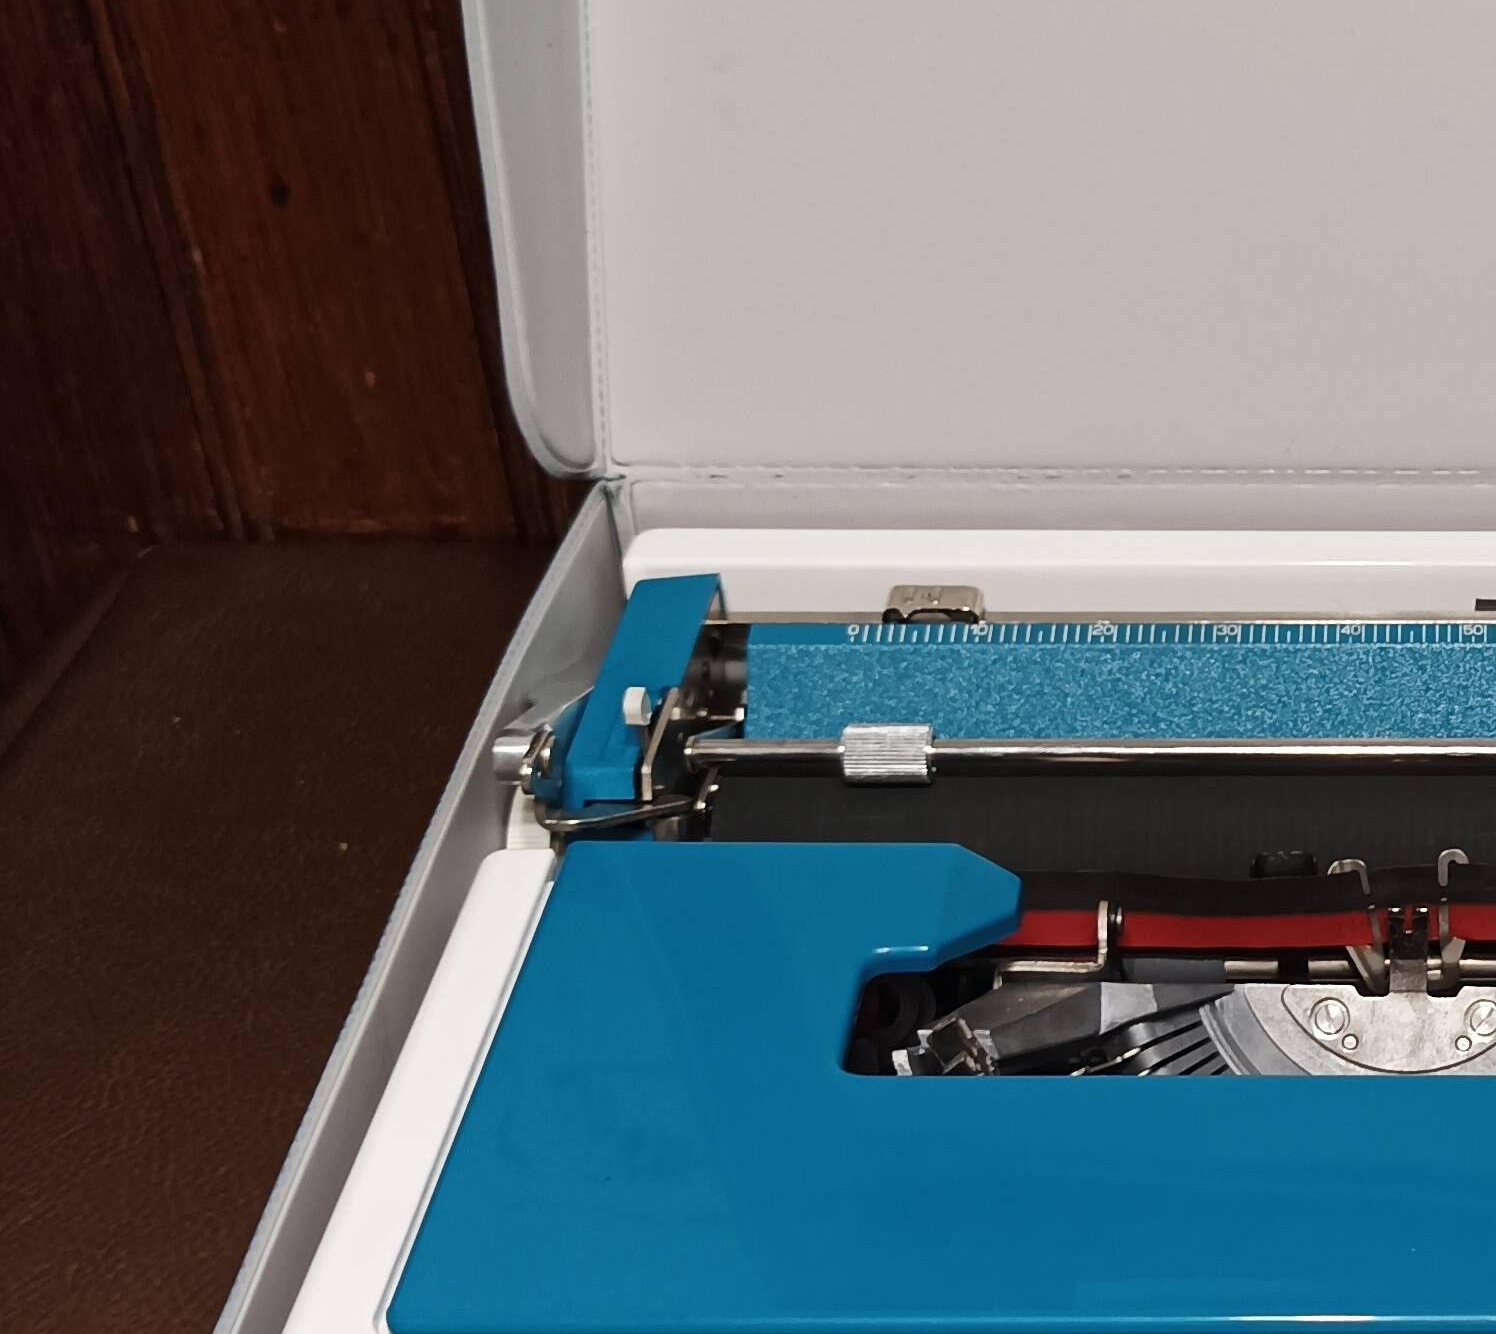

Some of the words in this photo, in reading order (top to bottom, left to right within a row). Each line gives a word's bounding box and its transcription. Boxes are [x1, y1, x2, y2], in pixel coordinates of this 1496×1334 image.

[1093, 623, 1114, 636] 20
[1216, 623, 1238, 636] 30
[1340, 623, 1362, 636] 40
[1463, 623, 1484, 636] 50
